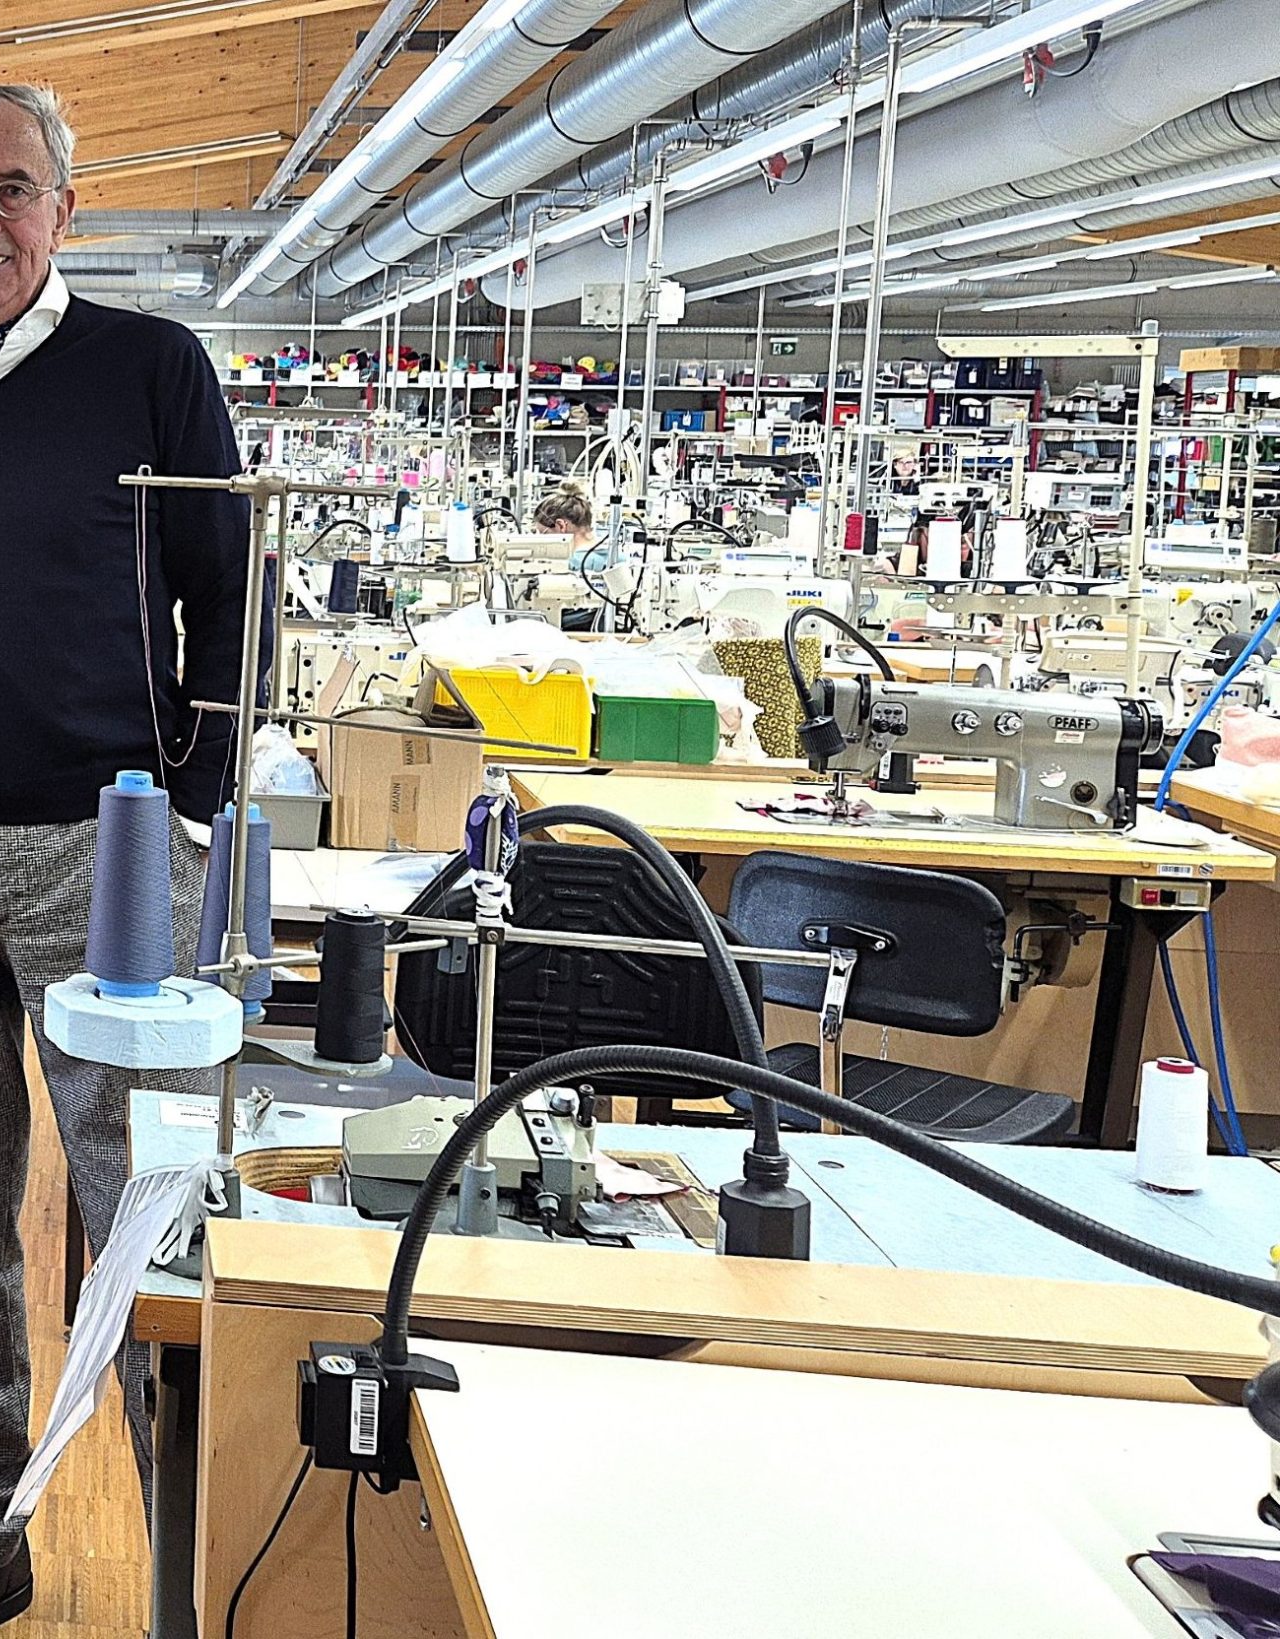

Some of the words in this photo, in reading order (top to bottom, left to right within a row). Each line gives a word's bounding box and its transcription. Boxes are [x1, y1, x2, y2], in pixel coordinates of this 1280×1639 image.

[786, 589, 823, 598] JUKI
[1200, 689, 1240, 698] JKI
[1054, 716, 1092, 730] PFAFF
[405, 740, 415, 766] MANN
[391, 783, 402, 814] AMANN
